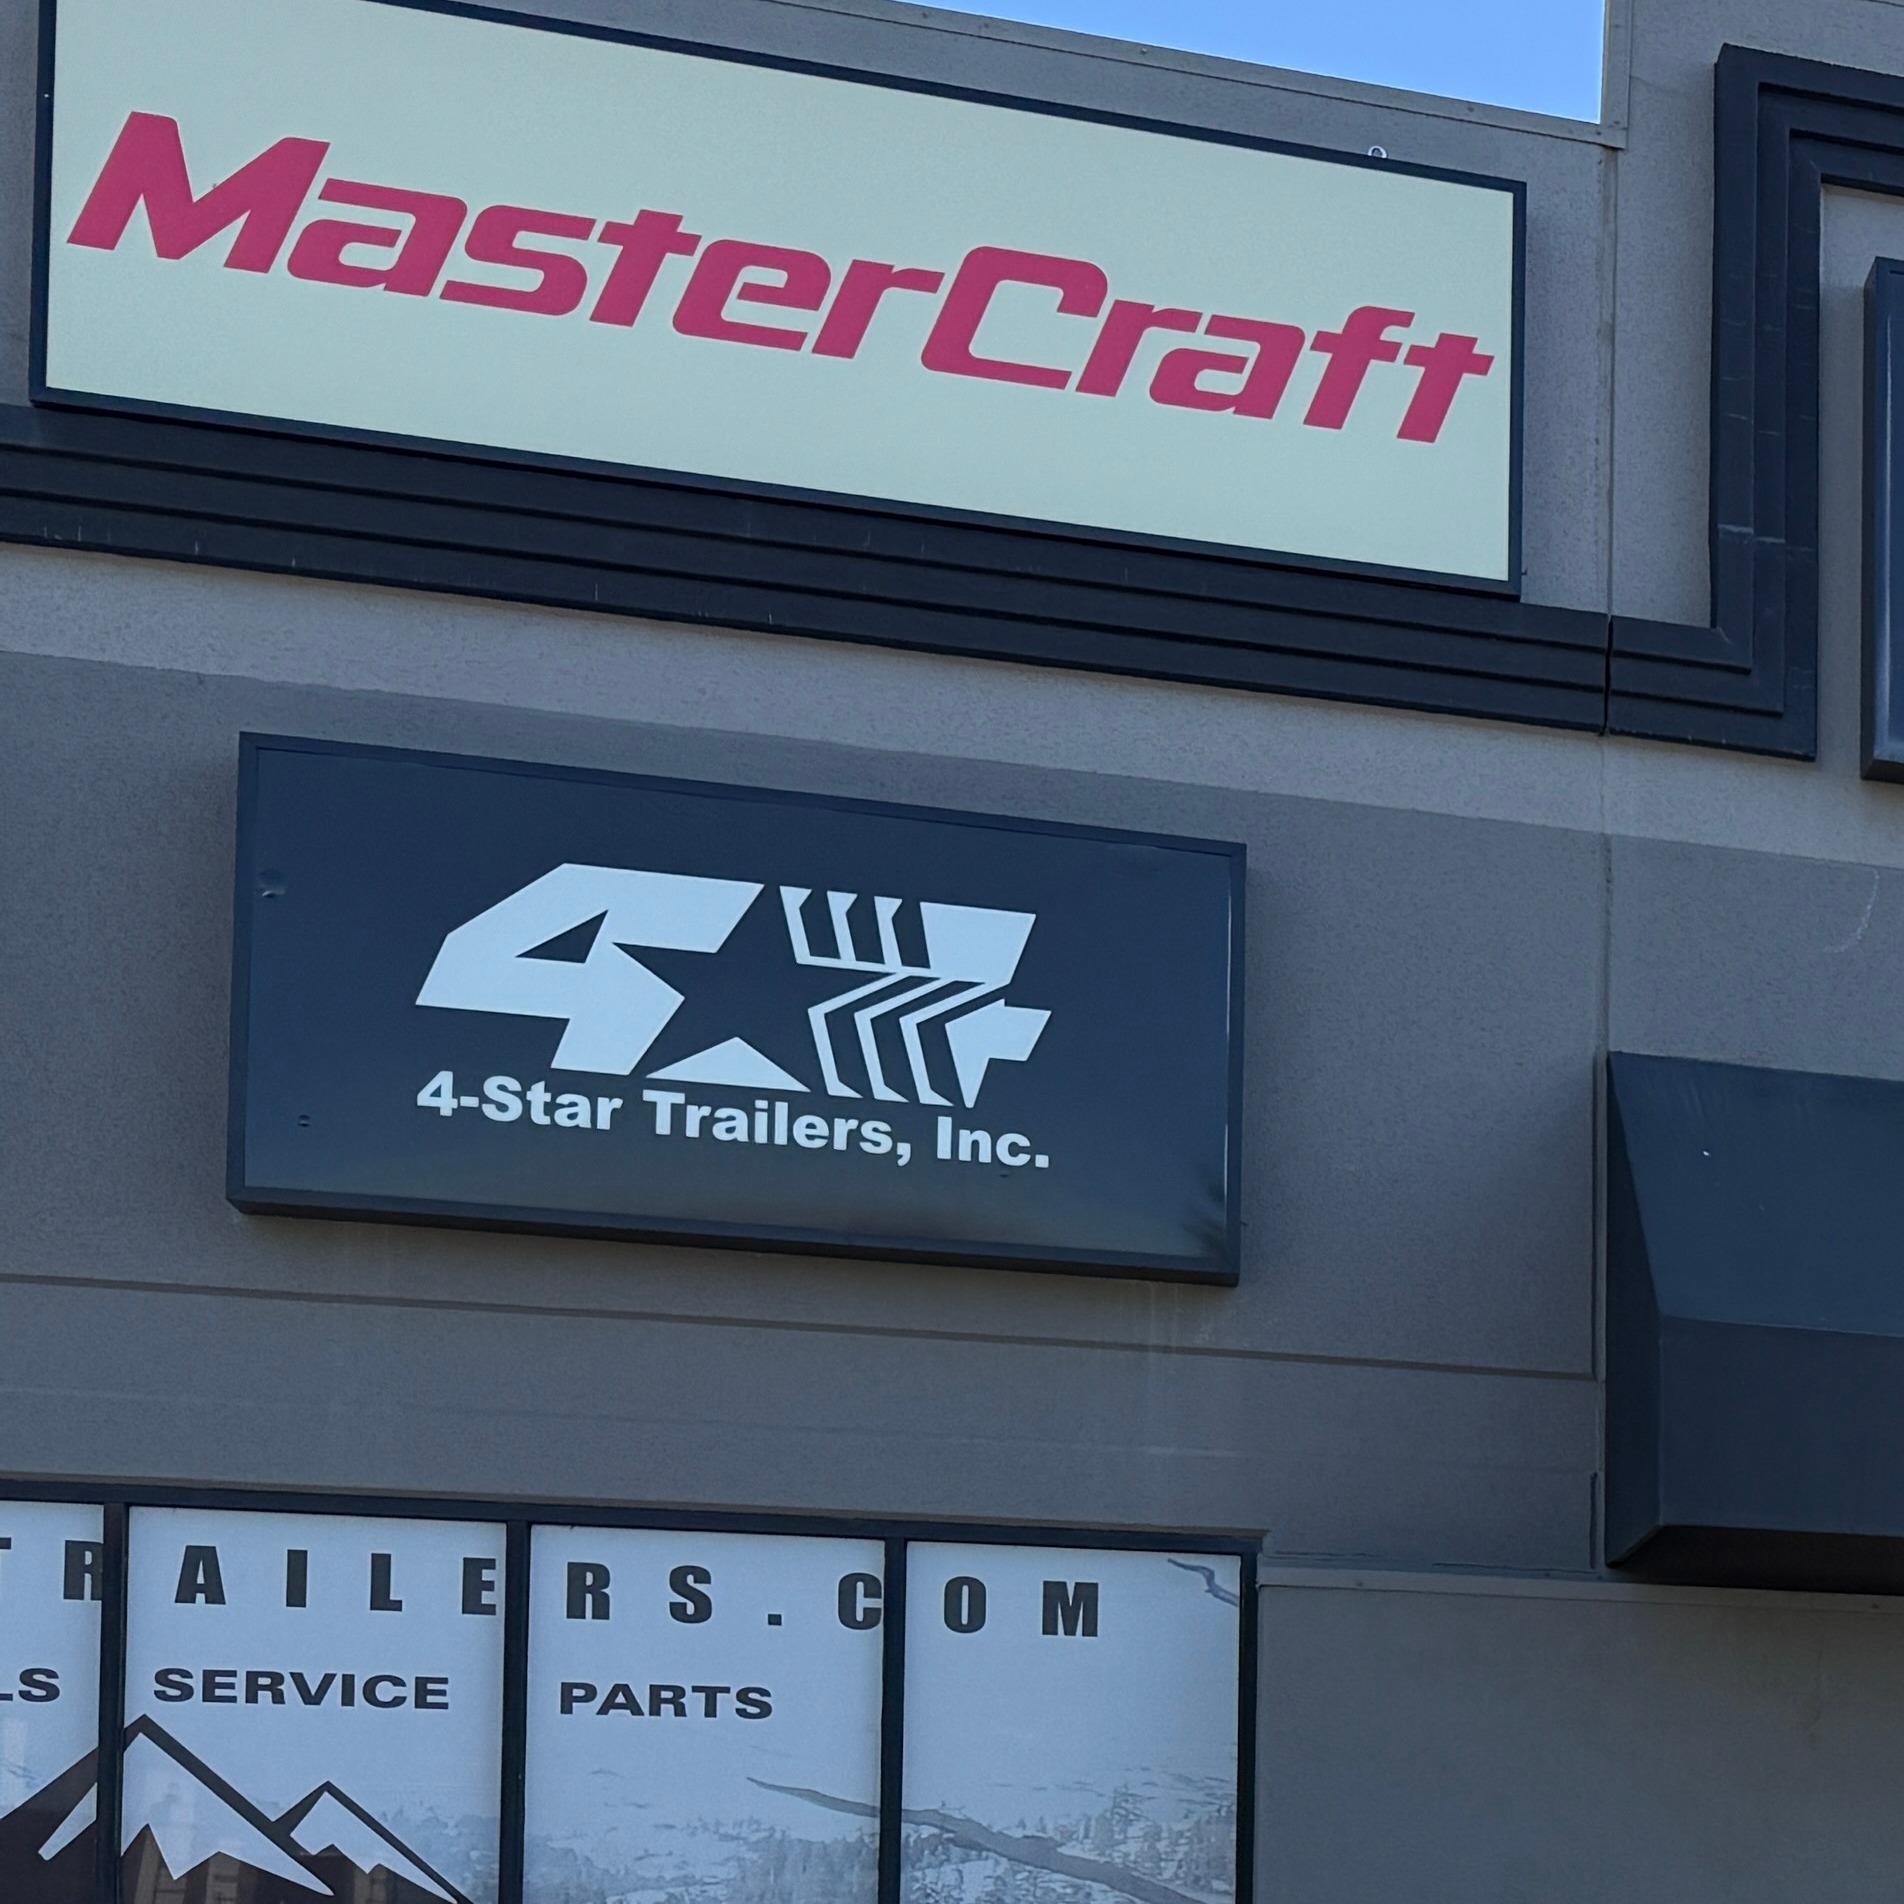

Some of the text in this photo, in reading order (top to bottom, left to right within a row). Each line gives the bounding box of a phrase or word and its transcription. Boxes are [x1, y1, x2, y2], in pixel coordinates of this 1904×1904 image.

[67, 111, 1495, 442] MasterCraft
[416, 1070, 1050, 1169] 4-Star Trailers, Inc.
[154, 1669, 449, 1710] SERVICE
[560, 1681, 774, 1721] PARTS
